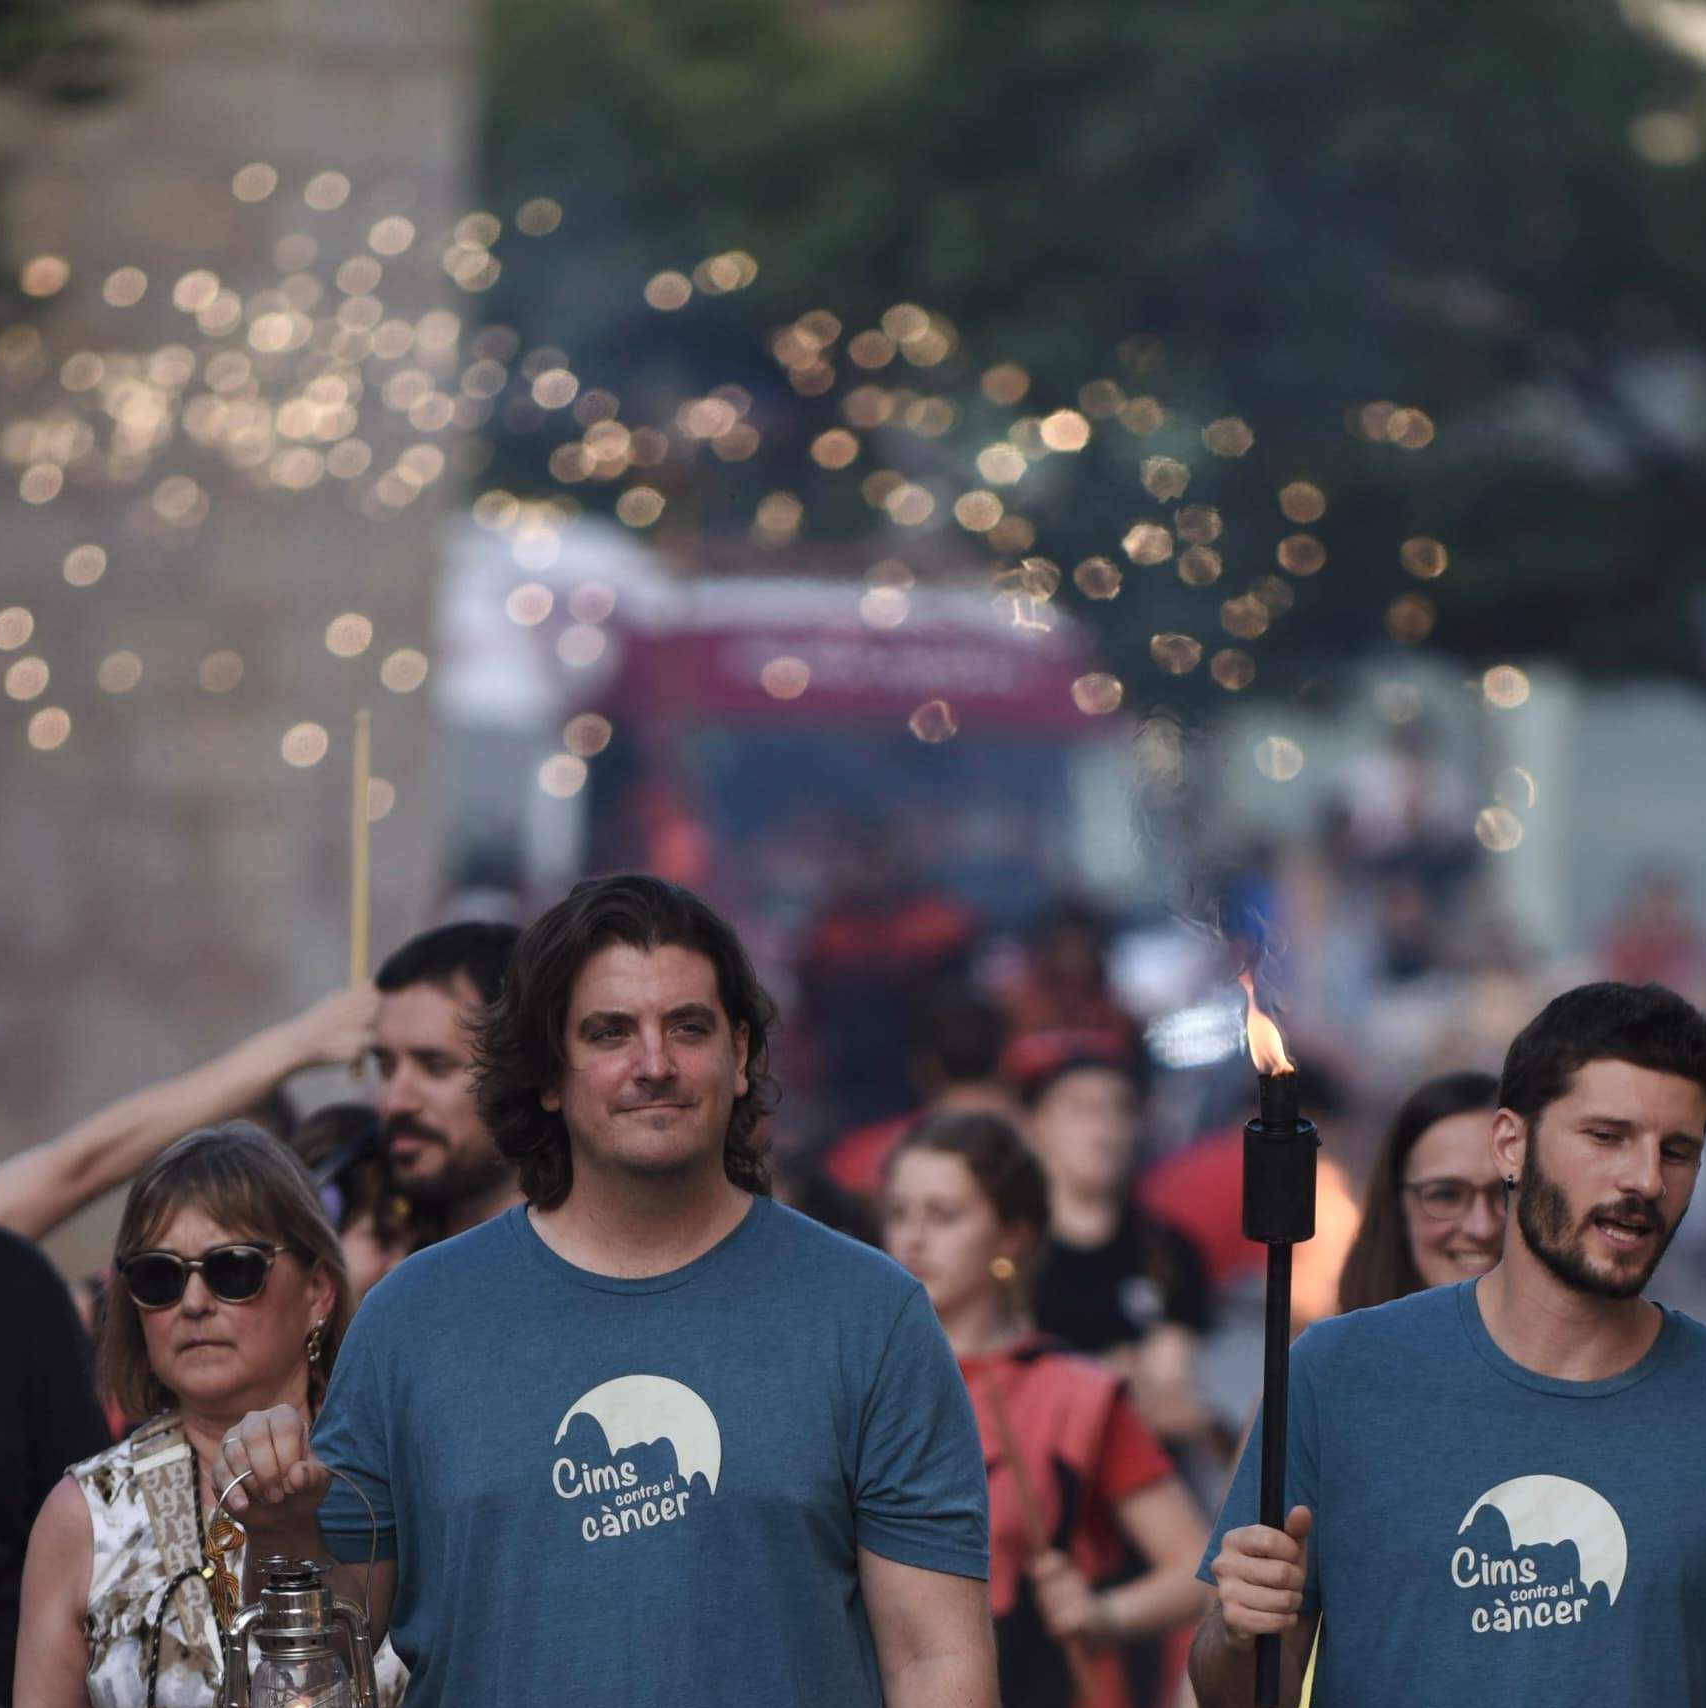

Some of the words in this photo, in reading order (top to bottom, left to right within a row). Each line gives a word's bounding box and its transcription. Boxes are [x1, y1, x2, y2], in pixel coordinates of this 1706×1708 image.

[552, 1457, 638, 1499] Cims
[615, 1484, 661, 1506] contra
[663, 1473, 675, 1492] el
[582, 1491, 690, 1542] càncer
[1451, 1546, 1538, 1589] Cims
[1510, 1584, 1558, 1603] contra
[1561, 1577, 1574, 1596] el
[1471, 1598, 1589, 1633] càncer
